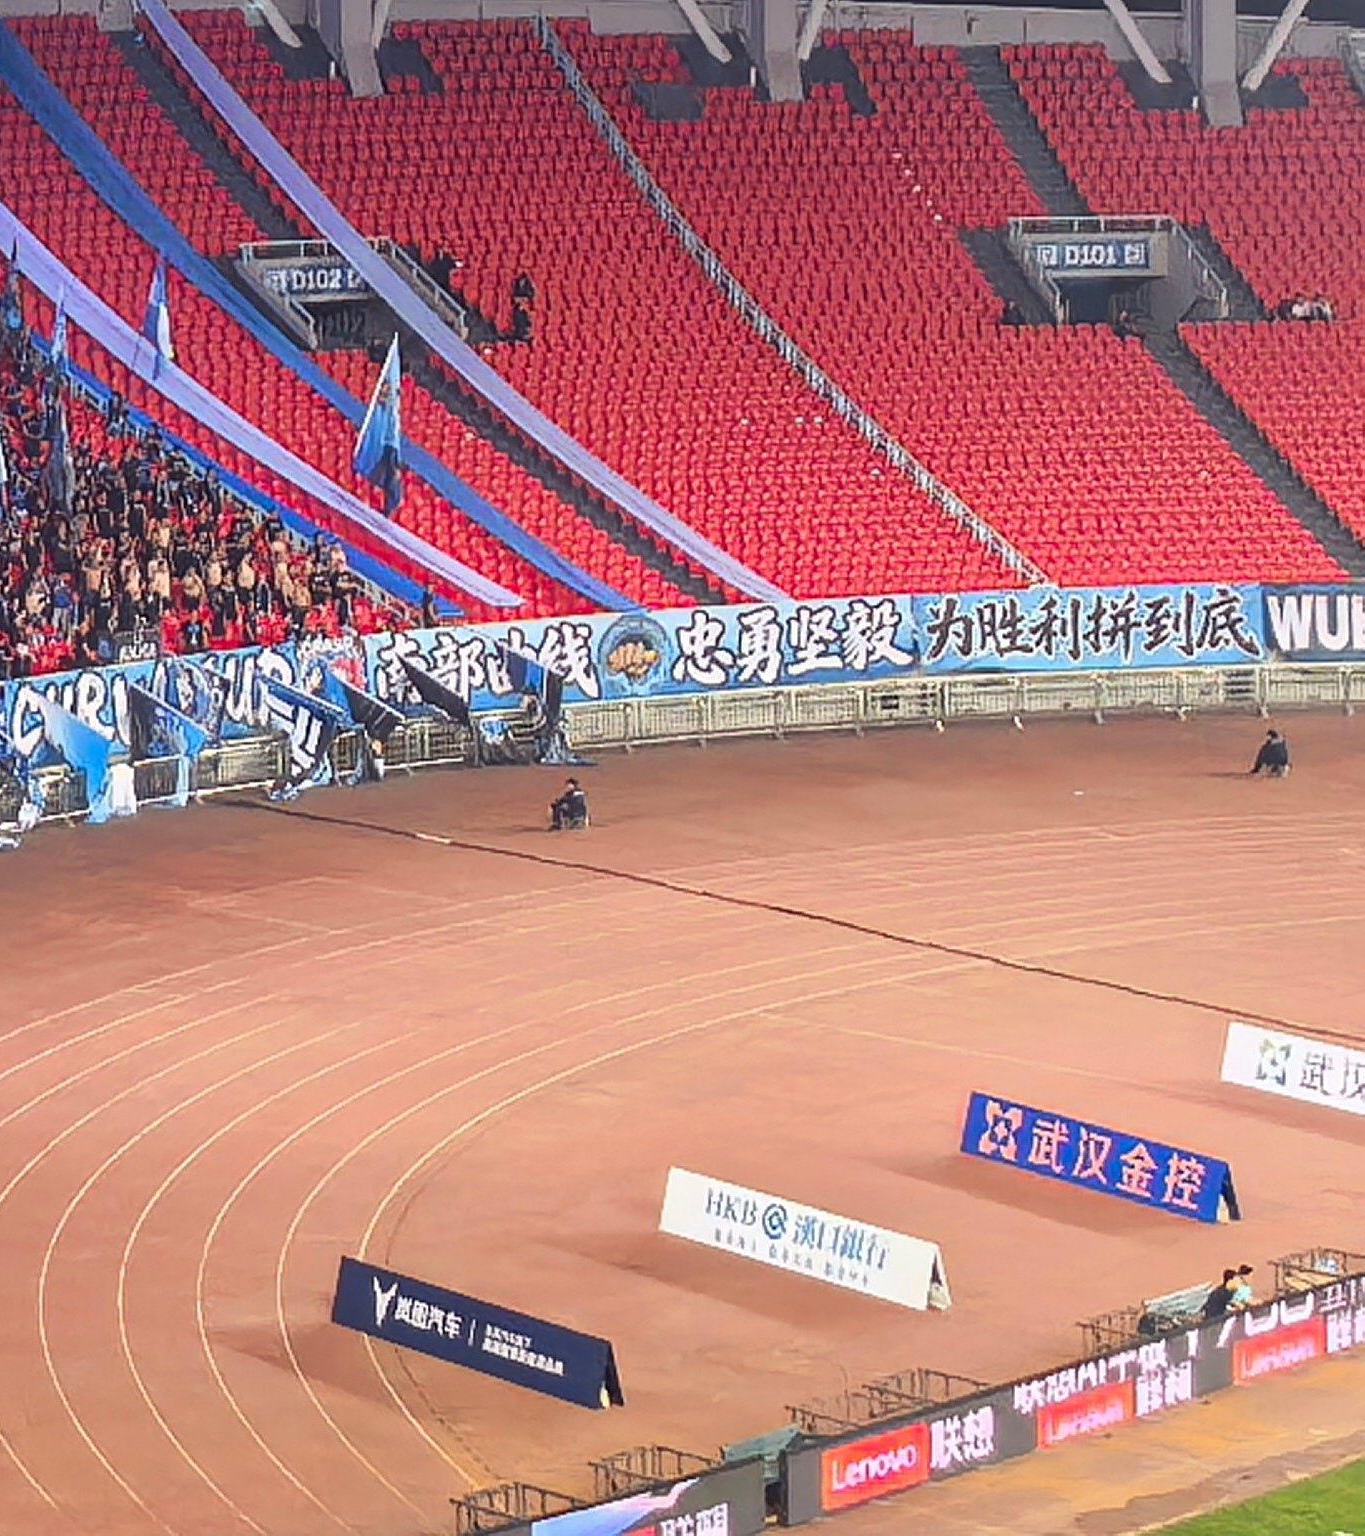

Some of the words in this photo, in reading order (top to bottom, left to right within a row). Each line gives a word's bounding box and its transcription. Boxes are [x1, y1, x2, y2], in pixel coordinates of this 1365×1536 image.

[291, 268, 342, 290] D102
[1065, 243, 1116, 266] D101
[671, 601, 919, 685] 忠勇坚毅
[925, 585, 1264, 662] 为胜利拼到底
[1028, 1119, 1205, 1210] 武汉金控
[705, 1187, 757, 1226] HKB
[929, 1406, 995, 1469] 联想
[832, 1444, 917, 1492] Lenovo
